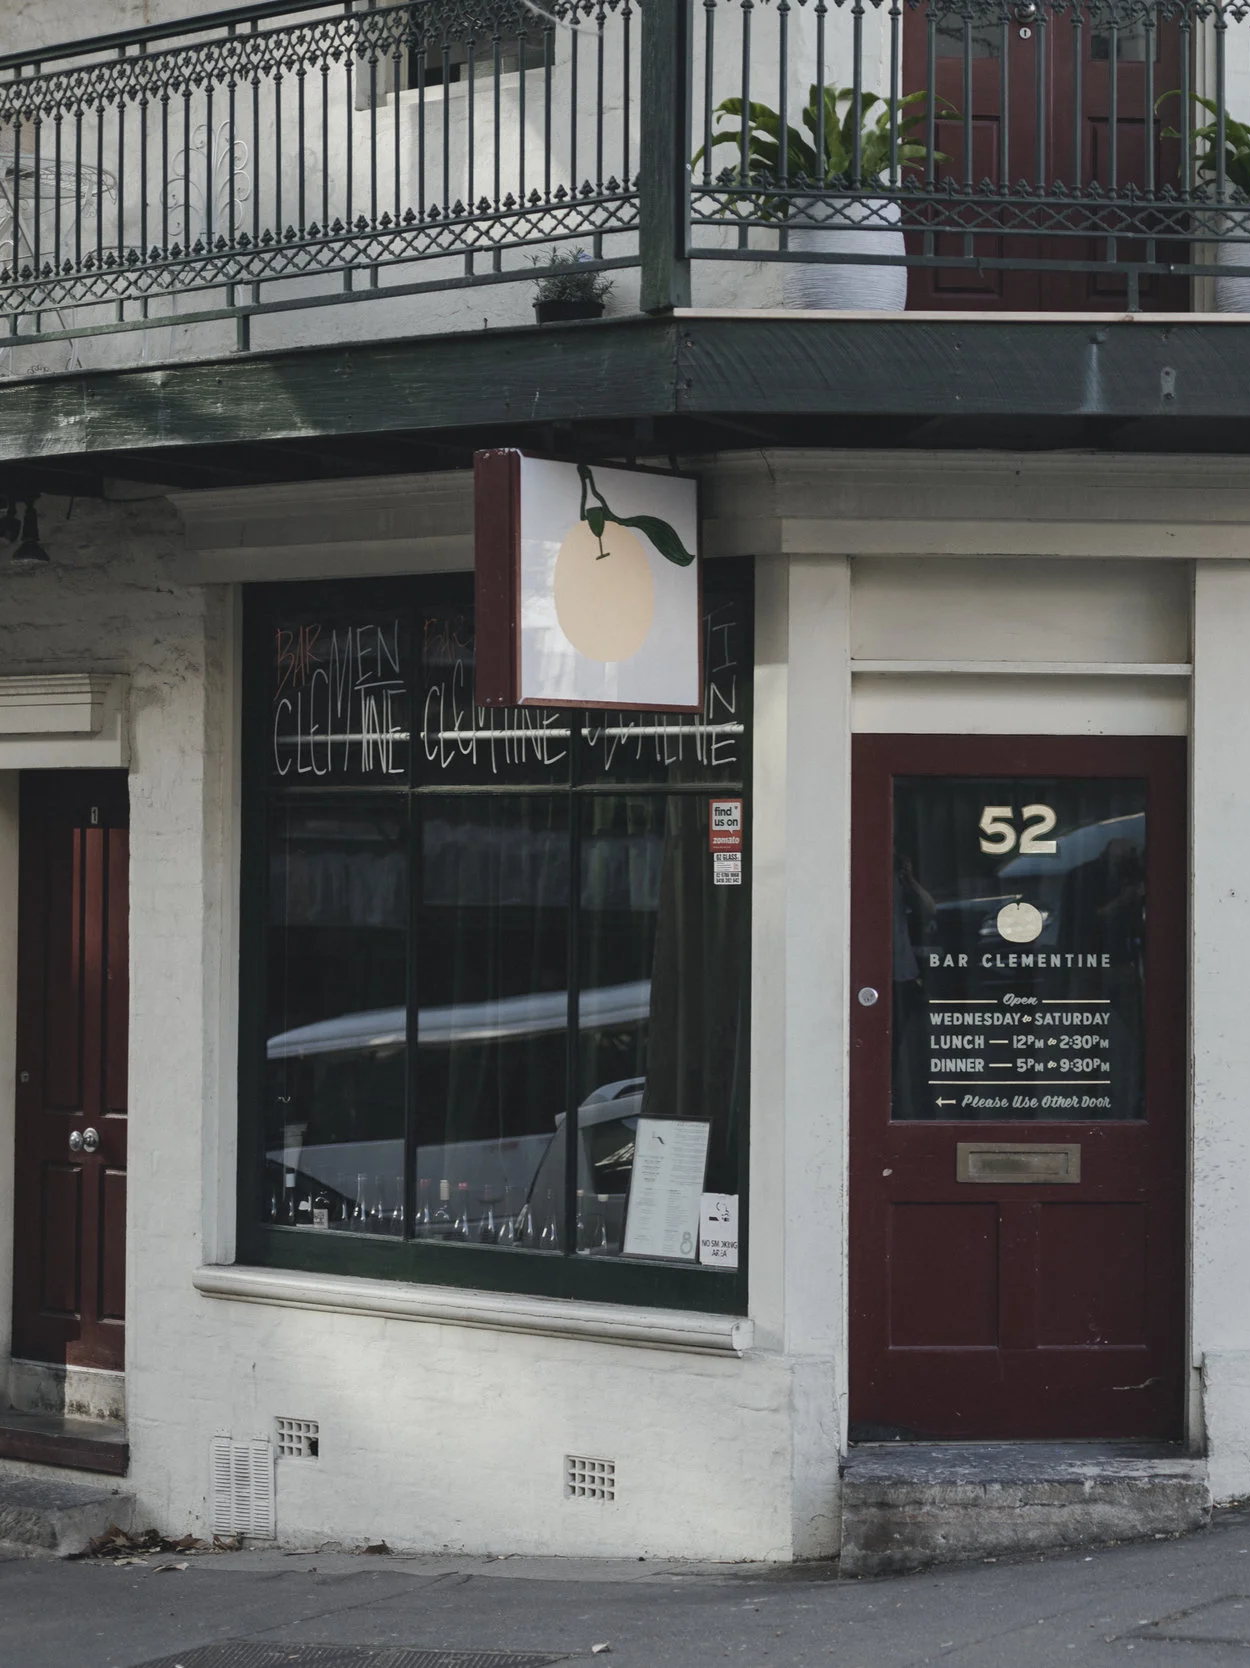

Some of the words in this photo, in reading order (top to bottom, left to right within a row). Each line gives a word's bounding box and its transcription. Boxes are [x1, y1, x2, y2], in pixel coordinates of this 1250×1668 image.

[274, 623, 323, 700] BAR
[714, 807, 732, 816] find
[714, 819, 725, 827] us
[727, 819, 738, 827] on
[979, 803, 1057, 855] 52
[712, 836, 740, 844] zomato
[929, 953, 968, 968] BAR
[982, 953, 1111, 968] CLEMENTINE
[1003, 993, 1037, 1006] Open
[930, 1012, 1020, 1025] WEDNESDAY
[1022, 1014, 1032, 1023] to
[1035, 1012, 1110, 1025] SATURDAY
[930, 1035, 985, 1049] LUNCH
[1013, 1035, 1044, 1049] 12PM
[1047, 1037, 1057, 1045] to
[1059, 1035, 1109, 1049] 2:30PM
[930, 1058, 985, 1072] DINNER
[1016, 1058, 1044, 1072] 5PM
[1047, 1060, 1057, 1068] to
[1059, 1058, 1110, 1072] 9:30PM
[961, 1094, 1009, 1108] Please
[1012, 1096, 1038, 1108] Use
[1041, 1095, 1080, 1108] Other
[1081, 1096, 1111, 1108] Door
[701, 1239, 710, 1247] NO
